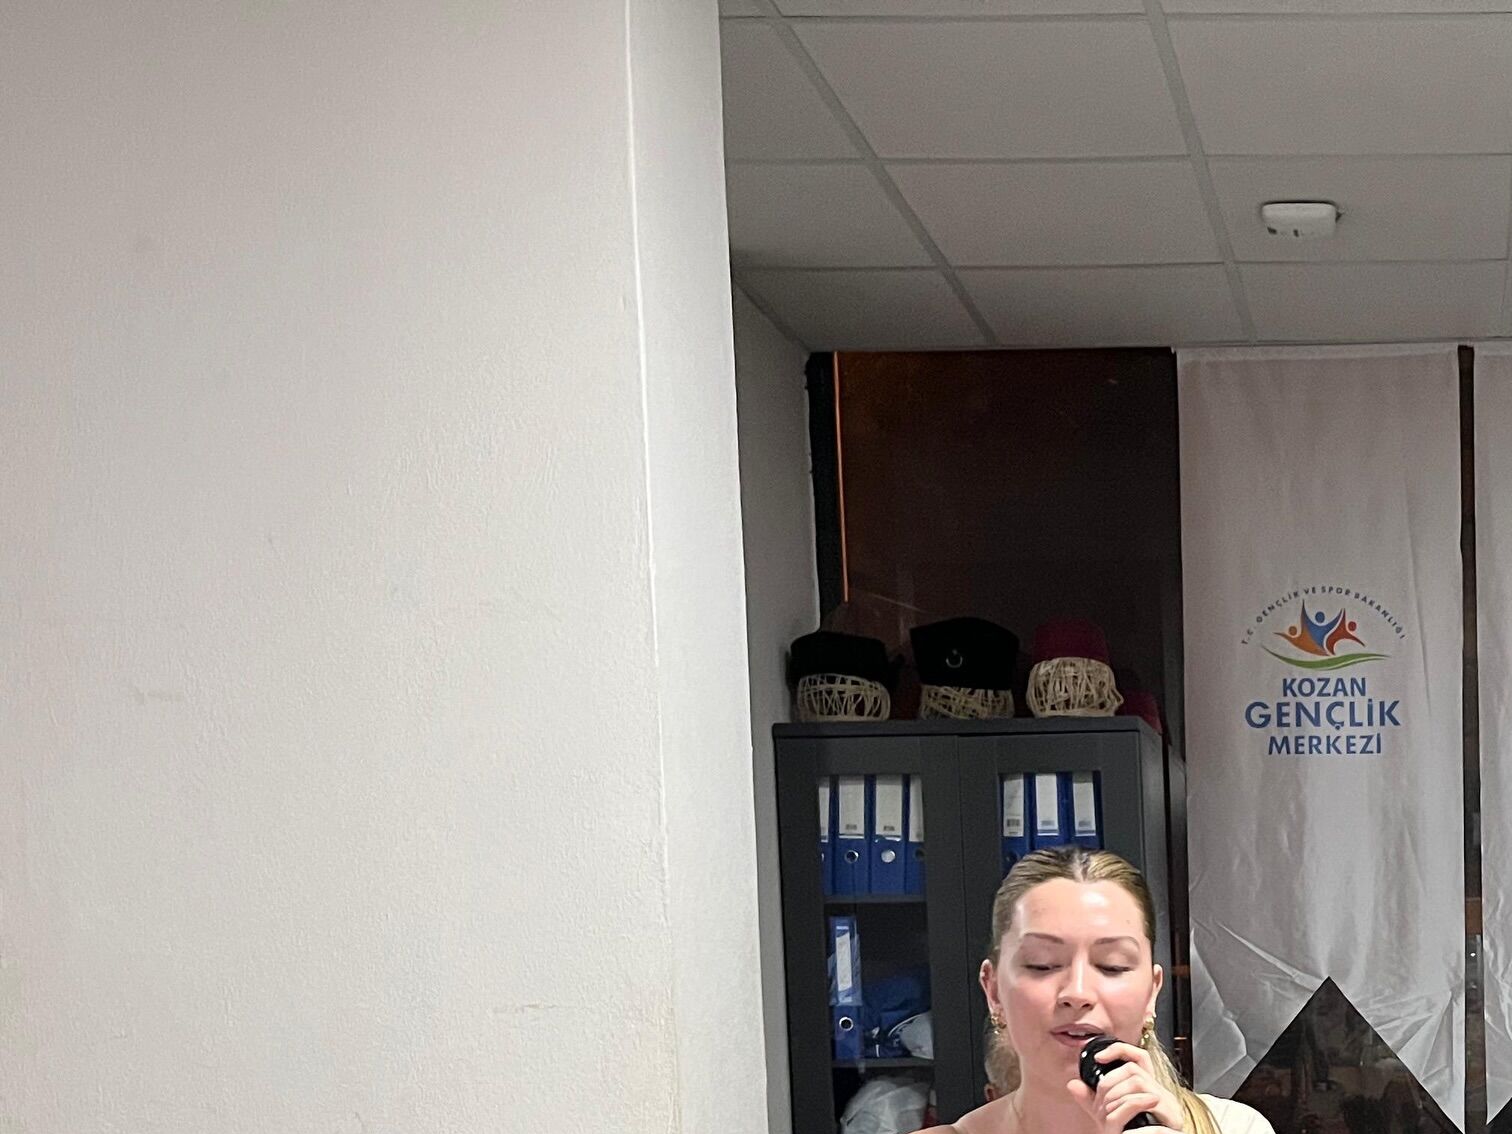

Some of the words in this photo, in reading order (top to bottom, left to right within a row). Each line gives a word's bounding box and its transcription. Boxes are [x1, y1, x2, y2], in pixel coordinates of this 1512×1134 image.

[1256, 590, 1299, 623] GENÇLİK
[1304, 586, 1316, 595] VE
[1354, 592, 1406, 640] BAKANLIĞI
[1283, 677, 1366, 698] KOZAN
[1245, 699, 1400, 730] GENÇLİK
[1268, 733, 1382, 755] MERKEZİ
